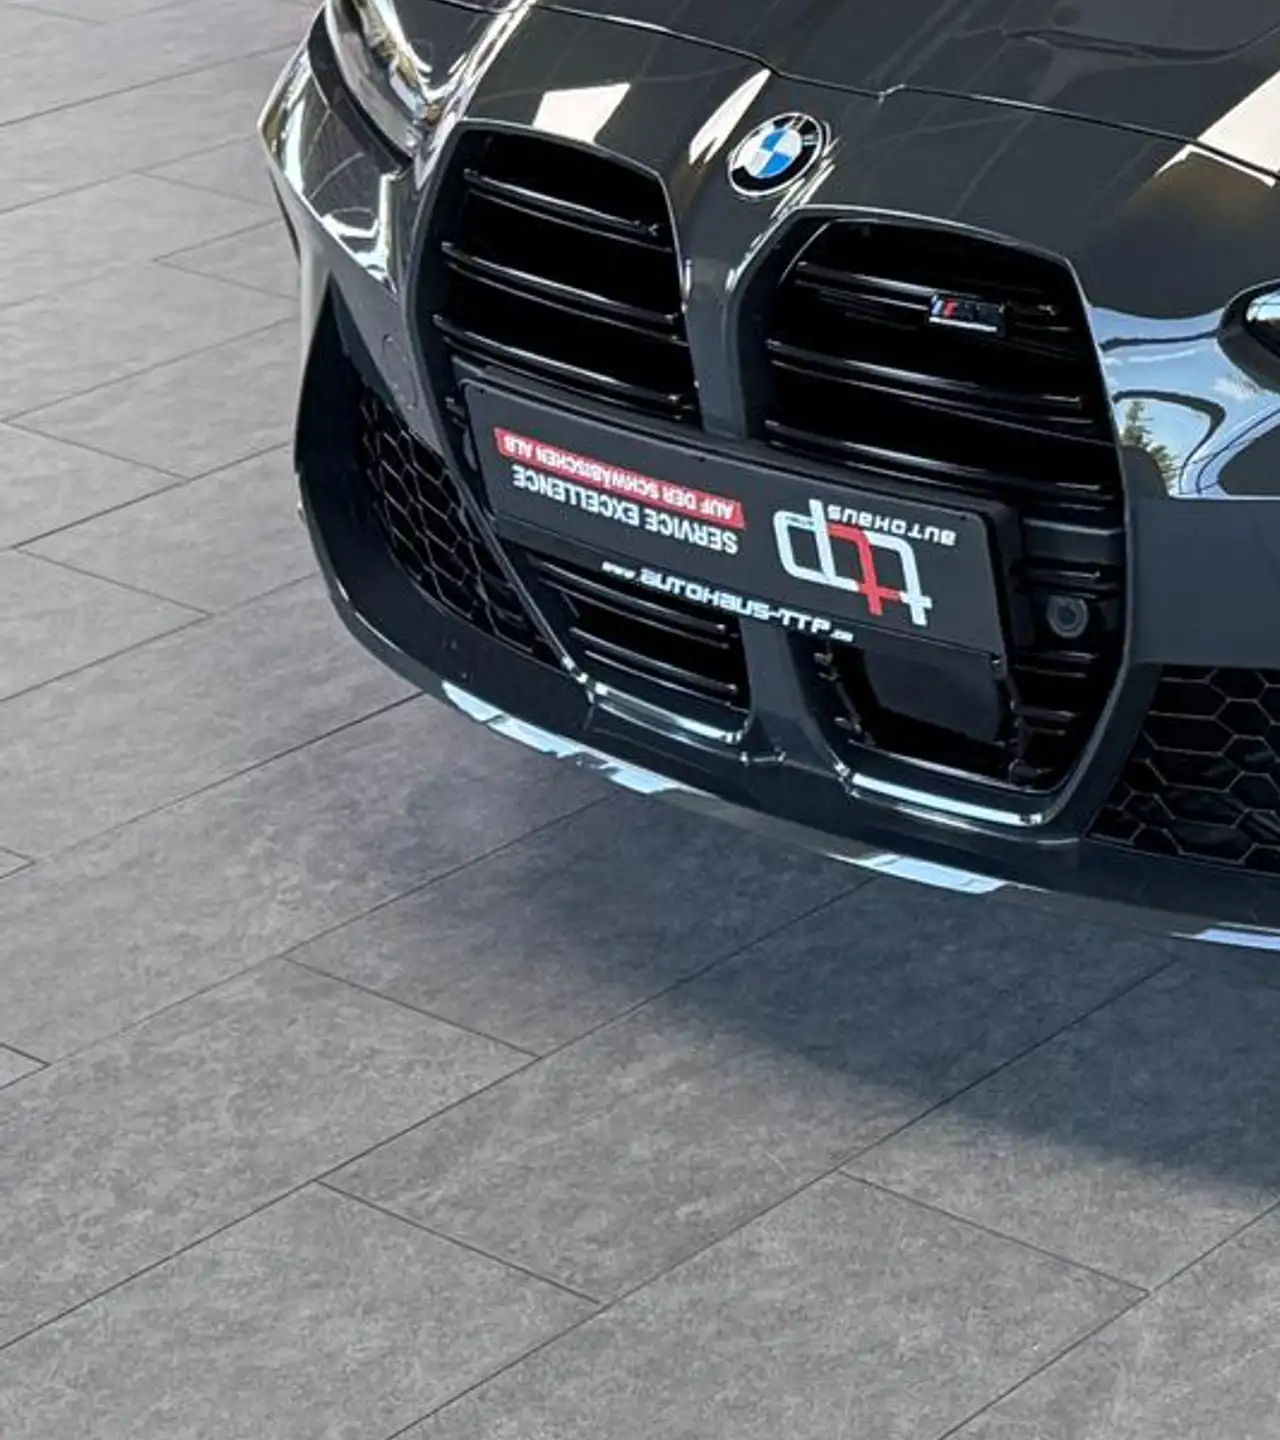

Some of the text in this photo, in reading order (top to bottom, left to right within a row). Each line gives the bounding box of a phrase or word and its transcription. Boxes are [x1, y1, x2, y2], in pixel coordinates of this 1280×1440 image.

[503, 435, 533, 458] ALB
[511, 464, 739, 555] SERVICE EXCELLENCE
[663, 489, 697, 509] DER
[700, 498, 734, 520] AUF
